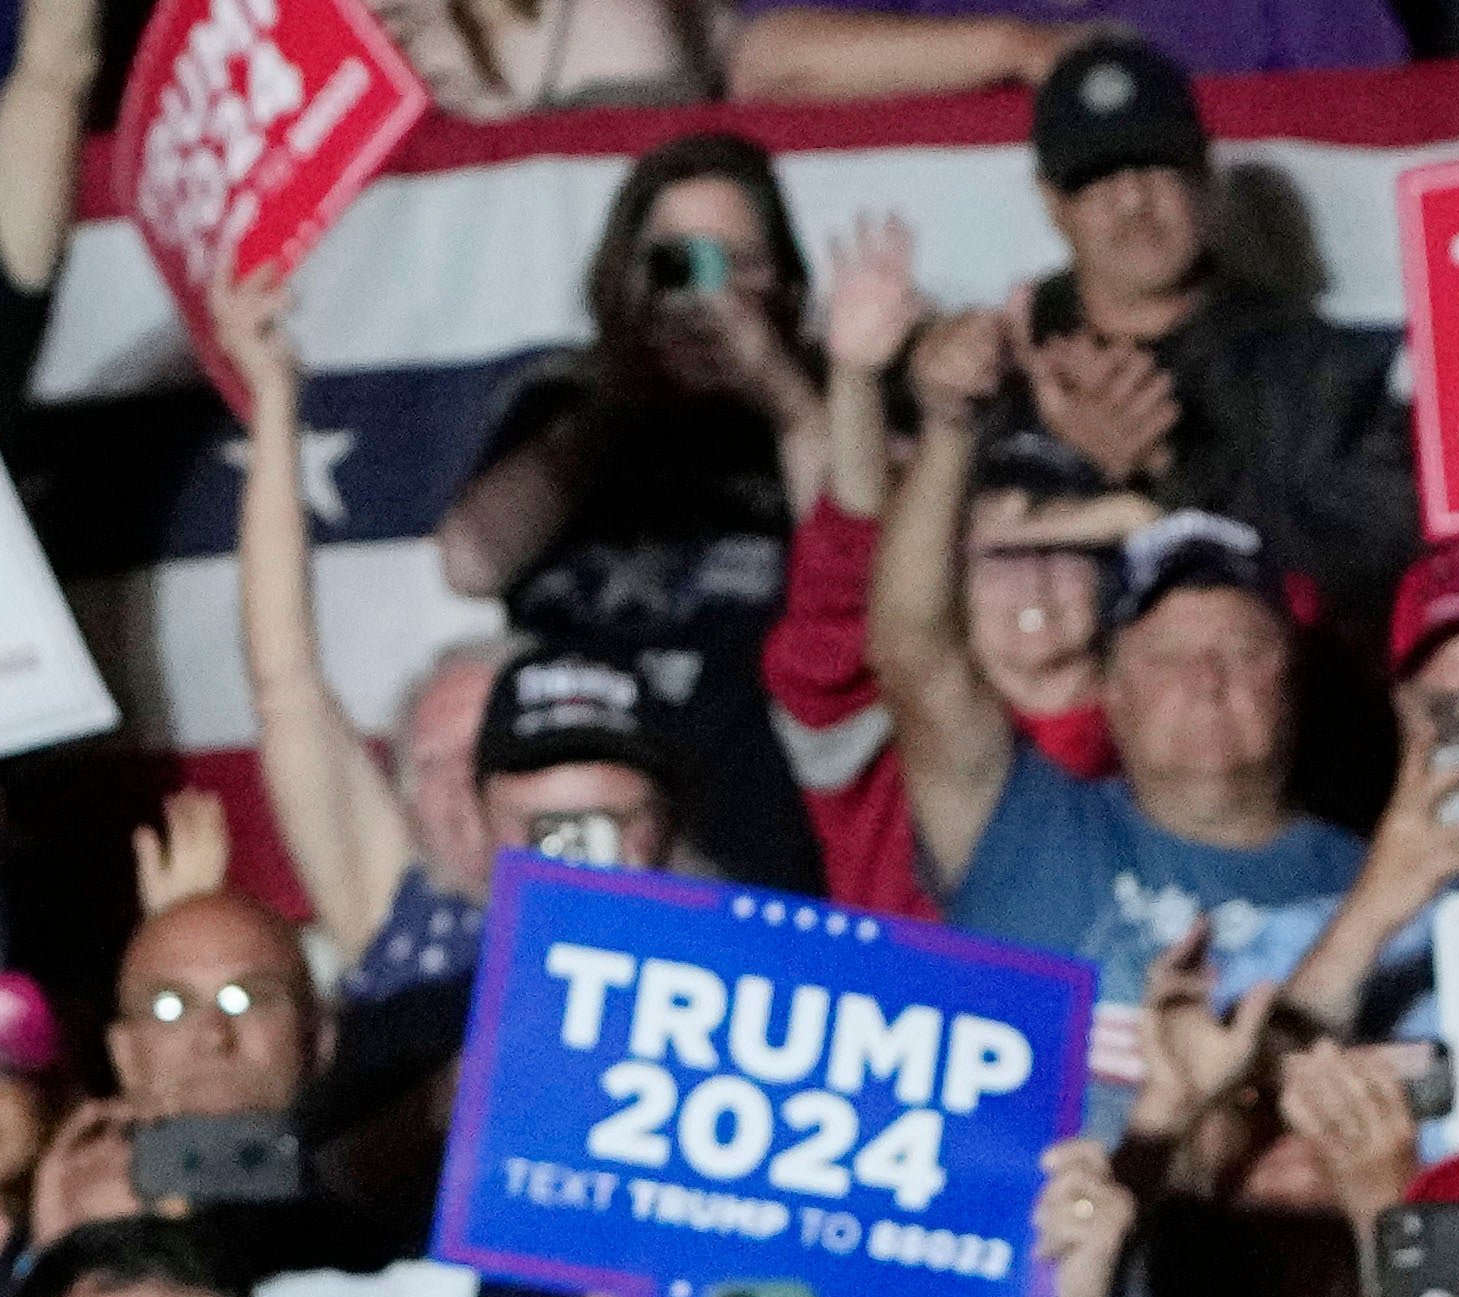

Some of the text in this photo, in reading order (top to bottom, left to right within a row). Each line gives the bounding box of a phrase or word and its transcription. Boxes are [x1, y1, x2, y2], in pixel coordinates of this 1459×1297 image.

[545, 942, 1034, 1113] TRUMP
[506, 1157, 620, 1213] TEXT
[628, 1178, 790, 1240] TRUMP
[800, 1205, 863, 1256] TO
[587, 1061, 946, 1212] 2024
